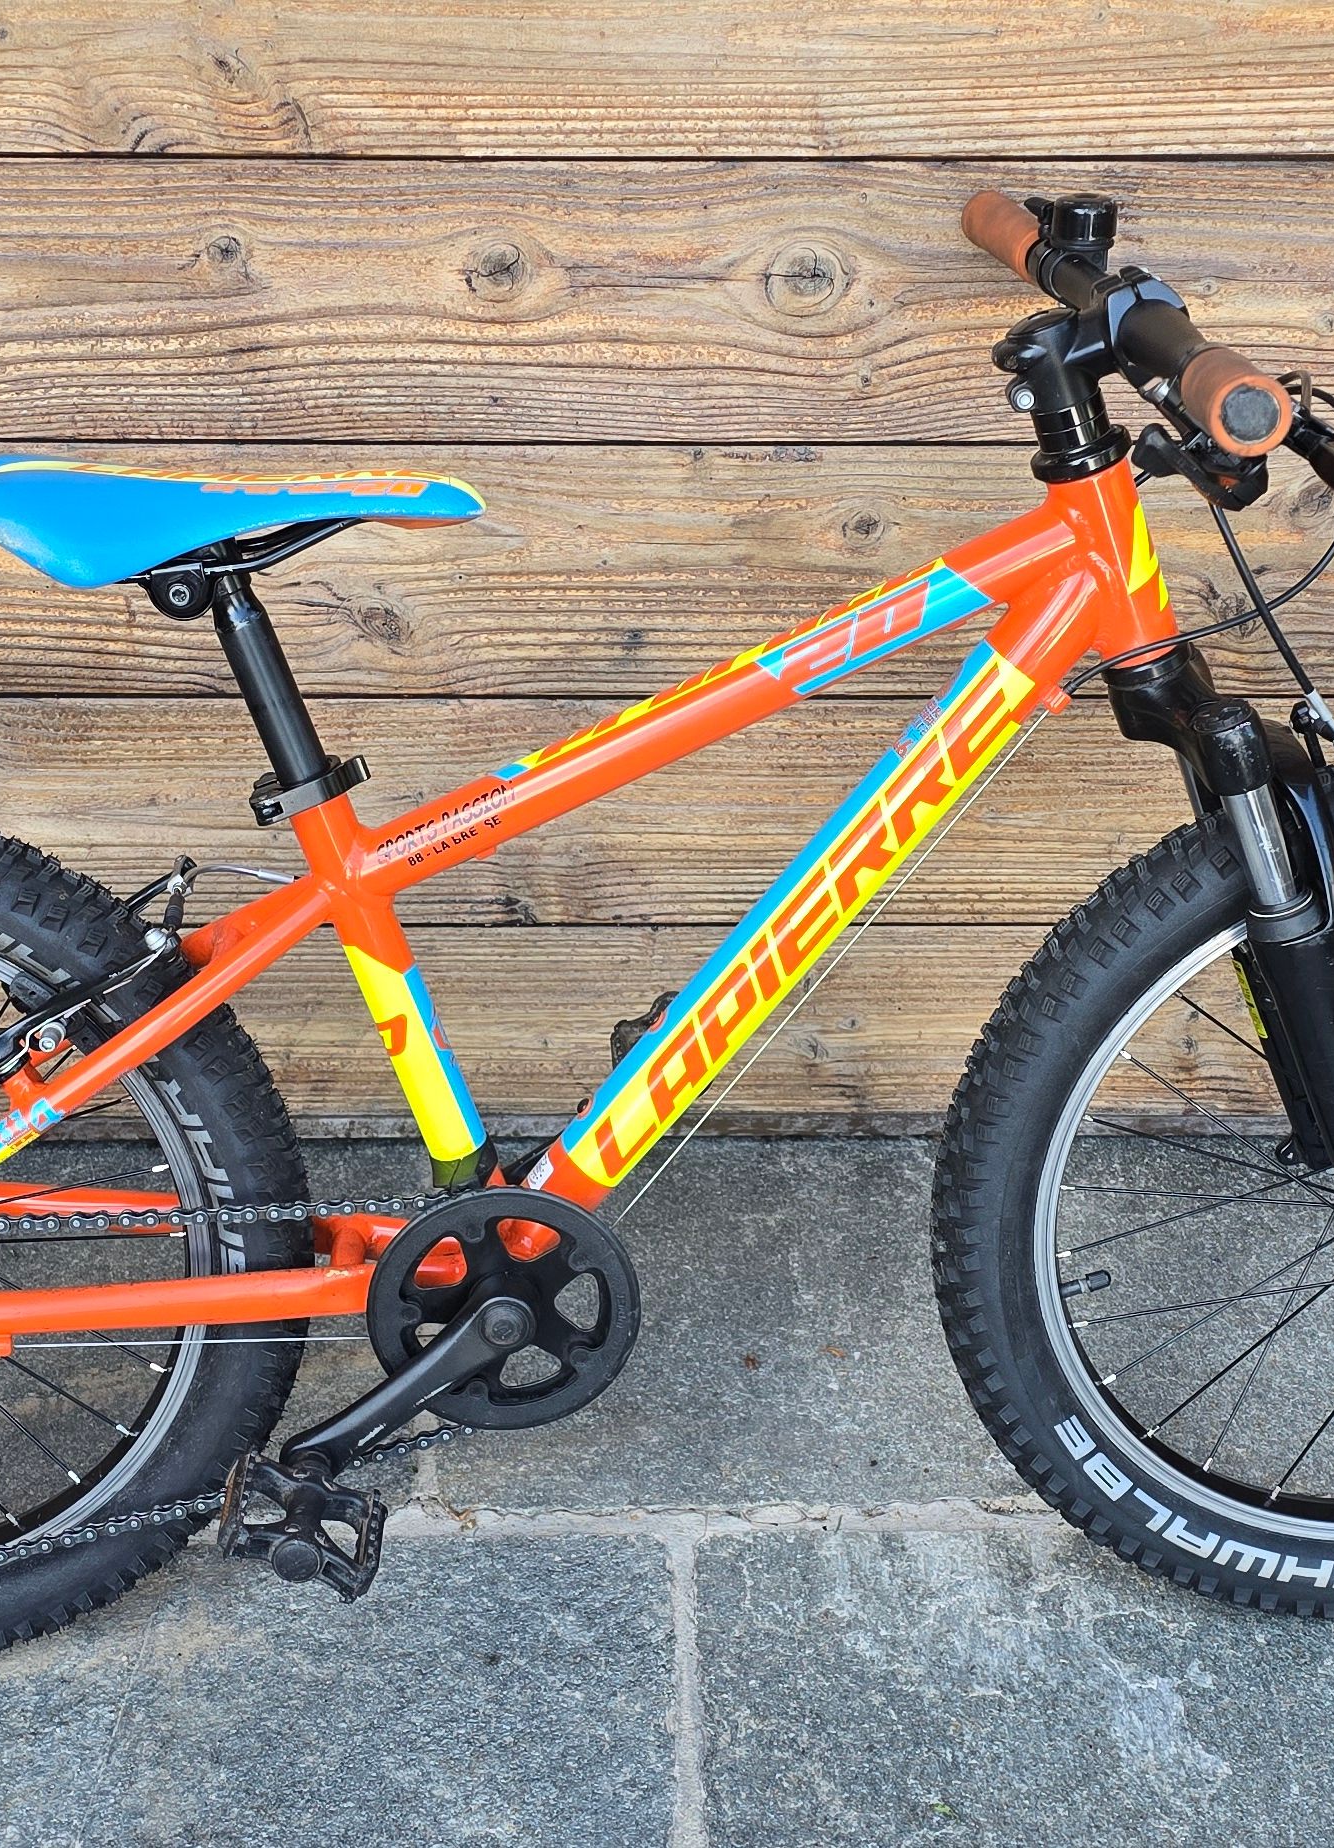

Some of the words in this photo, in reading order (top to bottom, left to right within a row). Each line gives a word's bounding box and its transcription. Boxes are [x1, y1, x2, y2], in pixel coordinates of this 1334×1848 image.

[376, 819, 439, 864] SPORTS
[441, 781, 517, 833] PASSION
[407, 853, 424, 867] 88
[433, 841, 450, 855] LA
[594, 663, 1018, 1181] LAPIERRE
